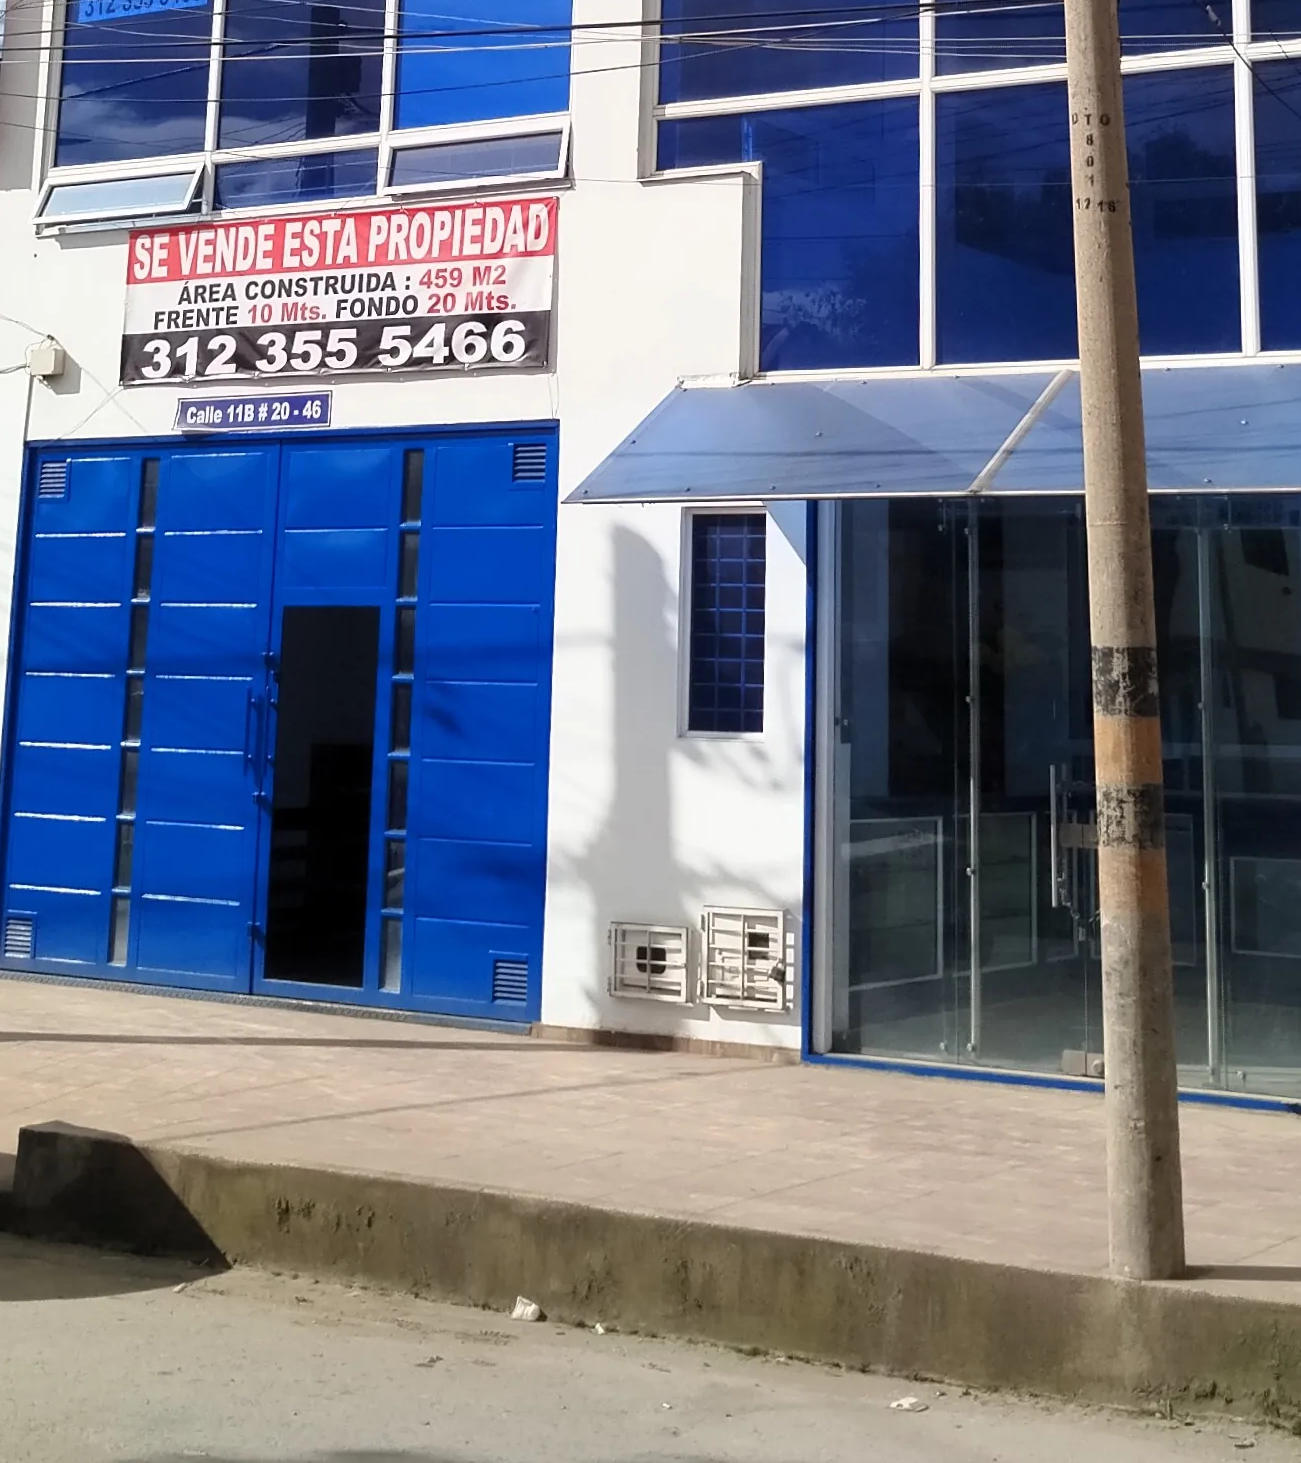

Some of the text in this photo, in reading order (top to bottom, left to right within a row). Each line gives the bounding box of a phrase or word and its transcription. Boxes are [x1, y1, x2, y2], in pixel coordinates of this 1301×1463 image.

[133, 203, 549, 280] SE VENDE ESTA PROPIEDAD
[177, 281, 238, 306] ÁREA
[245, 271, 397, 301] CONSTRUIDA
[419, 267, 463, 289] 459
[472, 264, 507, 287] M2
[153, 290, 517, 331] FRENTE 10 Mts. FONDO 20 Mts.
[141, 319, 526, 379] 312 355 5466
[186, 405, 223, 424] Calle
[226, 404, 255, 423] 11B
[258, 402, 268, 422] #
[270, 401, 290, 421] 20
[302, 400, 322, 419] 46
